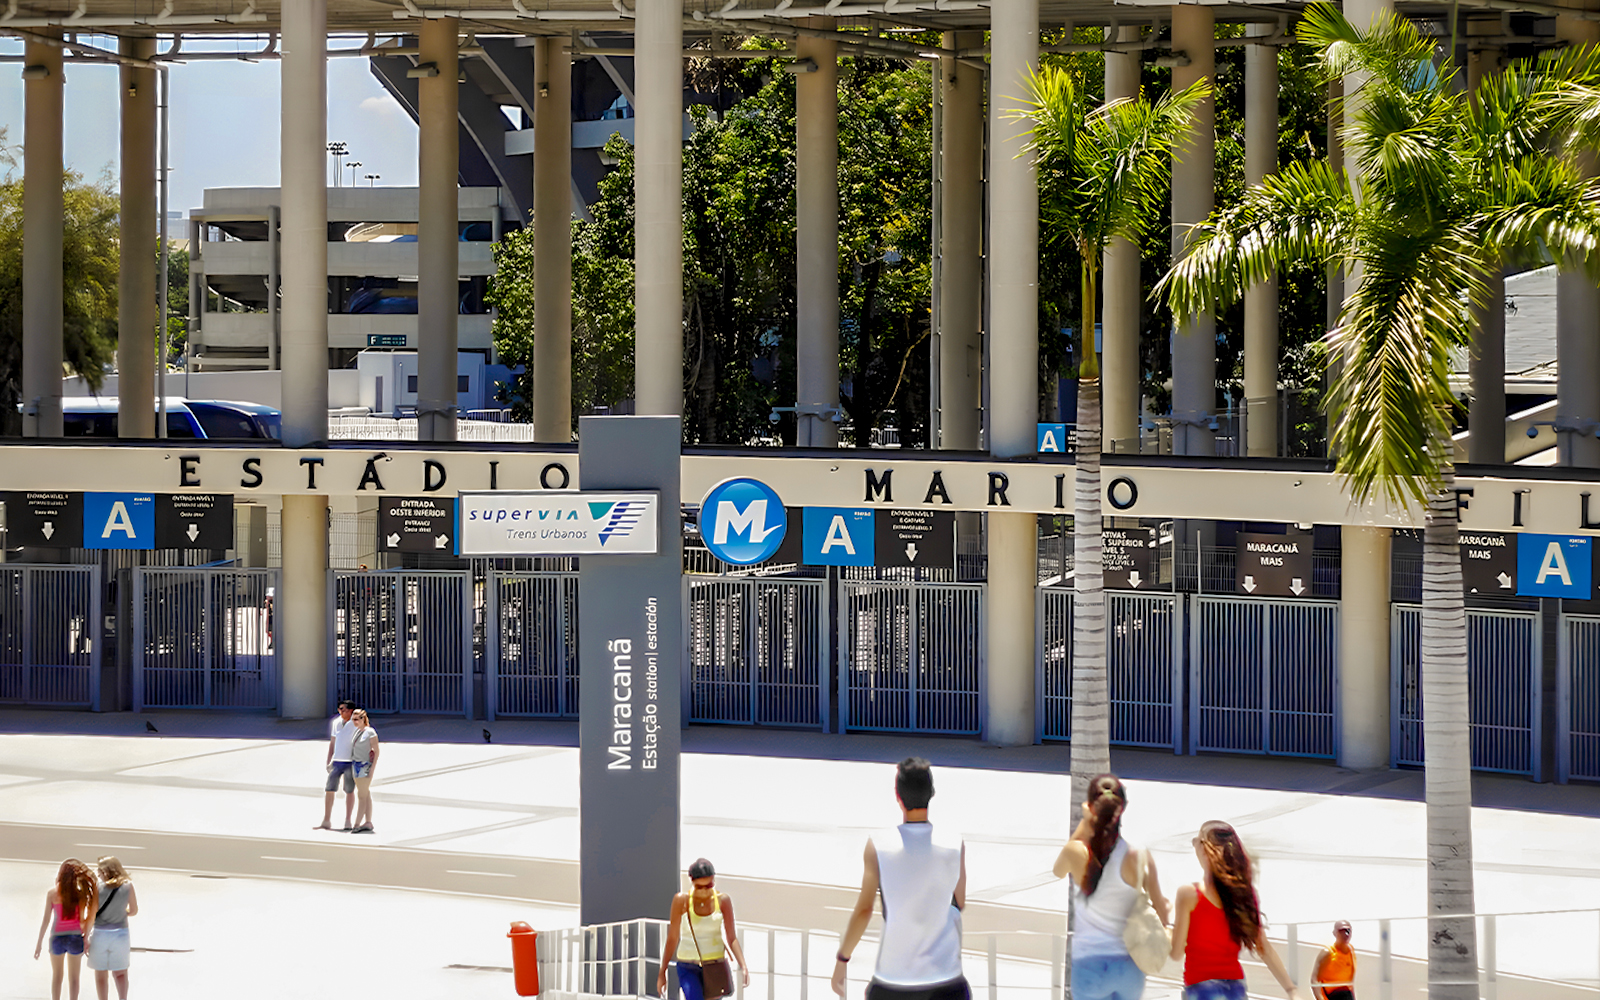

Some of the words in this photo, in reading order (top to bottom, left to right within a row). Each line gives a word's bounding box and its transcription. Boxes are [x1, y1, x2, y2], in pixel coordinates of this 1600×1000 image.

[1040, 430, 1059, 452] A
[179, 453, 570, 492] ESTÁDIO
[864, 468, 1138, 510] MARIO
[401, 500, 435, 508] ENTRADA
[414, 509, 446, 517] INFERIOR
[101, 501, 136, 538] A
[507, 529, 537, 539] Trens
[540, 529, 588, 539] Urbanos
[821, 515, 856, 555] A
[1108, 539, 1144, 547] SUPERIOR
[1247, 542, 1299, 554] MARACANÃ
[1458, 535, 1506, 546] MARACANÃ
[1260, 556, 1284, 566] MAIS
[1468, 550, 1492, 560] MAIS
[1536, 542, 1572, 585] A
[646, 596, 658, 650] estación
[646, 657, 658, 700] station
[608, 639, 632, 770] Maracanã
[642, 703, 662, 770] Estação
